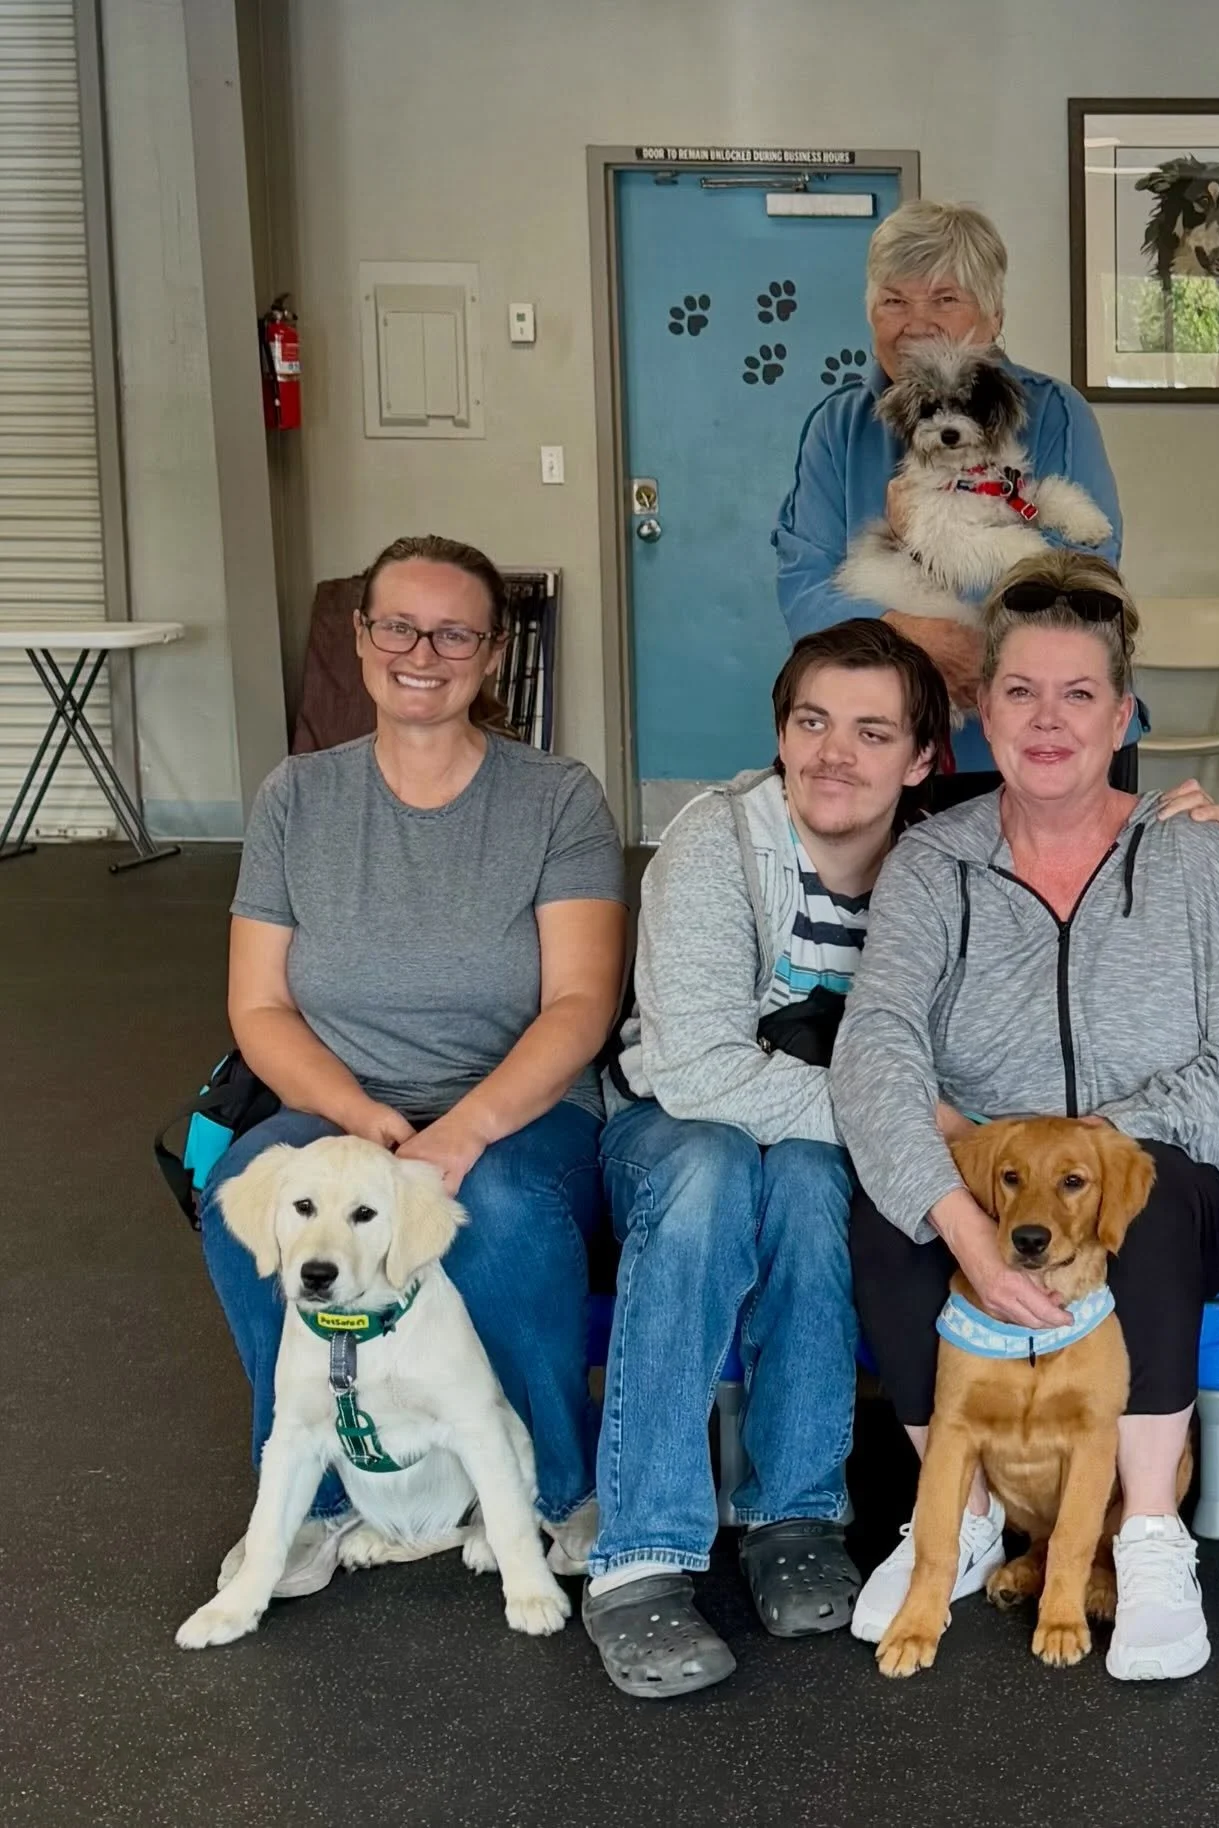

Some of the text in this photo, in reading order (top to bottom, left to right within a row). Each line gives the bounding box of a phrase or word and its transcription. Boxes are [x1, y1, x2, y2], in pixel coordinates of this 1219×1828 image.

[642, 148, 850, 163] DOOR TO REMAIN UNLOCKED DURING BUSINESS HOURS
